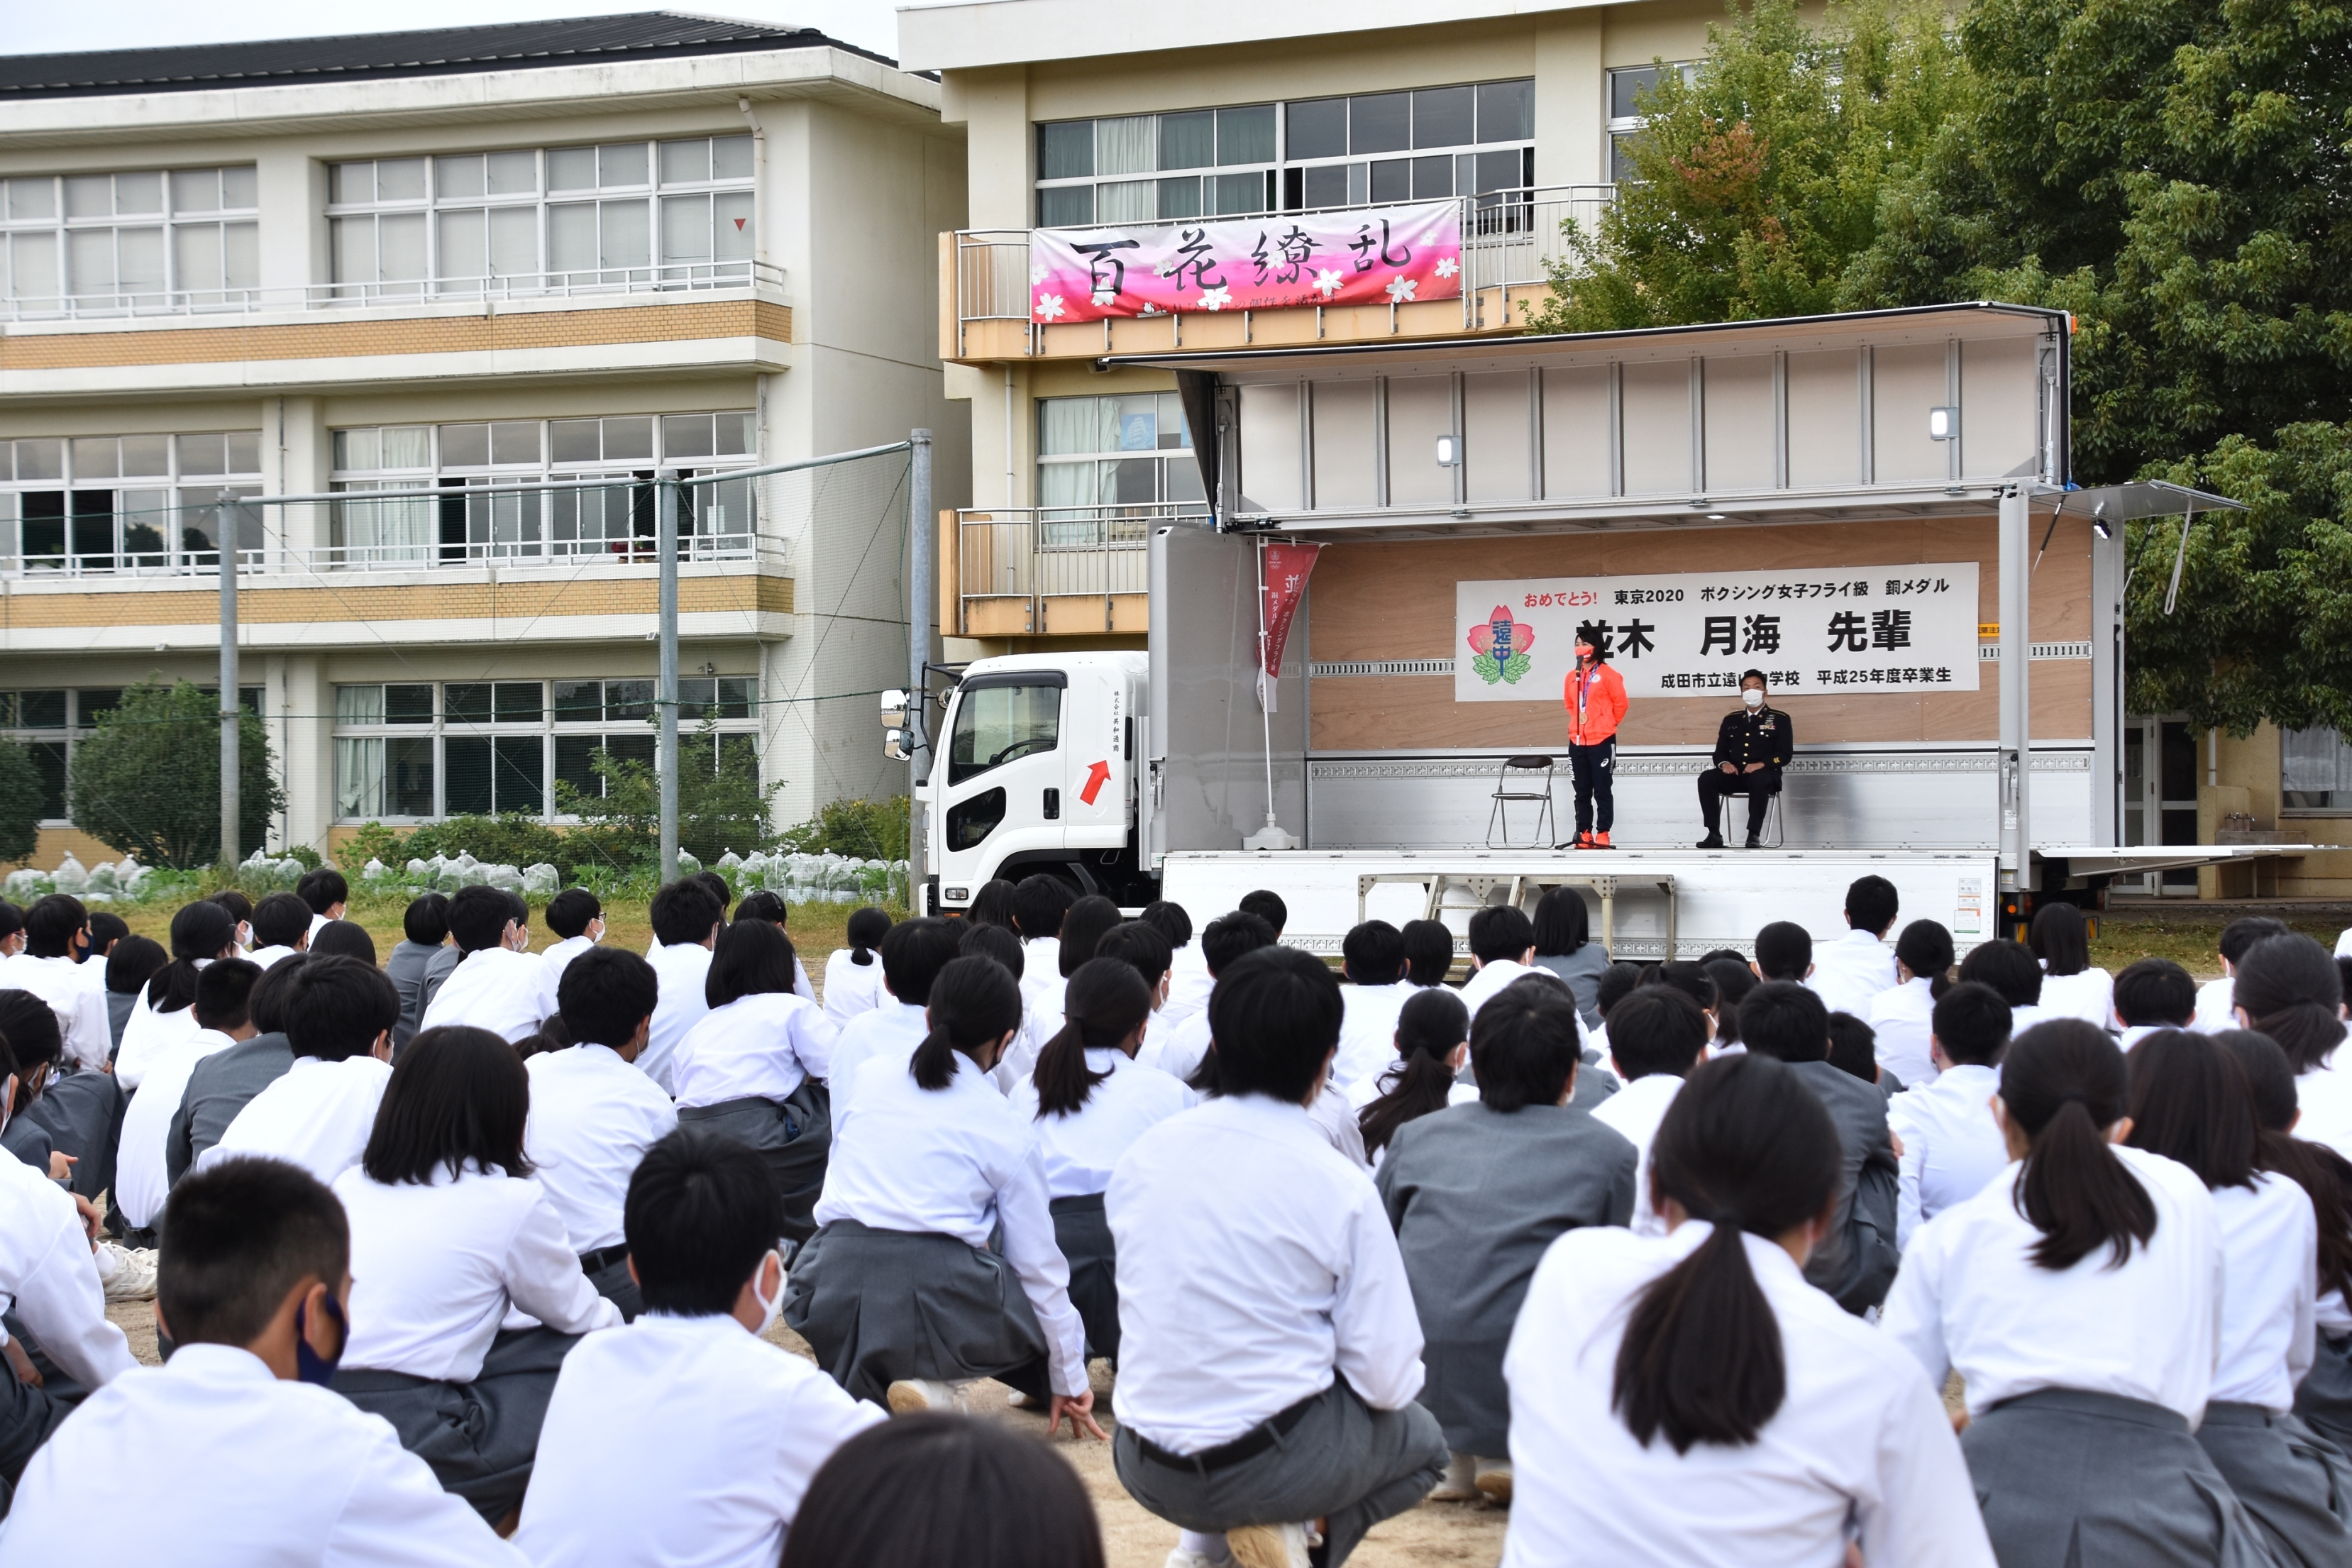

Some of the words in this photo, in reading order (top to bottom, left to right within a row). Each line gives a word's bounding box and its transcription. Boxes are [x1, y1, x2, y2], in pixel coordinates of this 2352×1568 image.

[1069, 218, 1411, 296] 百花繚乱
[1140, 292, 1339, 314] ひとりひとりの個性を活かす
[1614, 589, 1684, 604] 東京2020
[1701, 580, 1869, 602] ボクシング女子フライ級
[1885, 578, 1950, 595] 銅メダル
[1700, 614, 1781, 656] 月海
[1827, 609, 1911, 652] 先輩
[1661, 670, 1800, 688] 成田市立遠学校
[1816, 667, 1952, 685] 平成25年度卒業生
